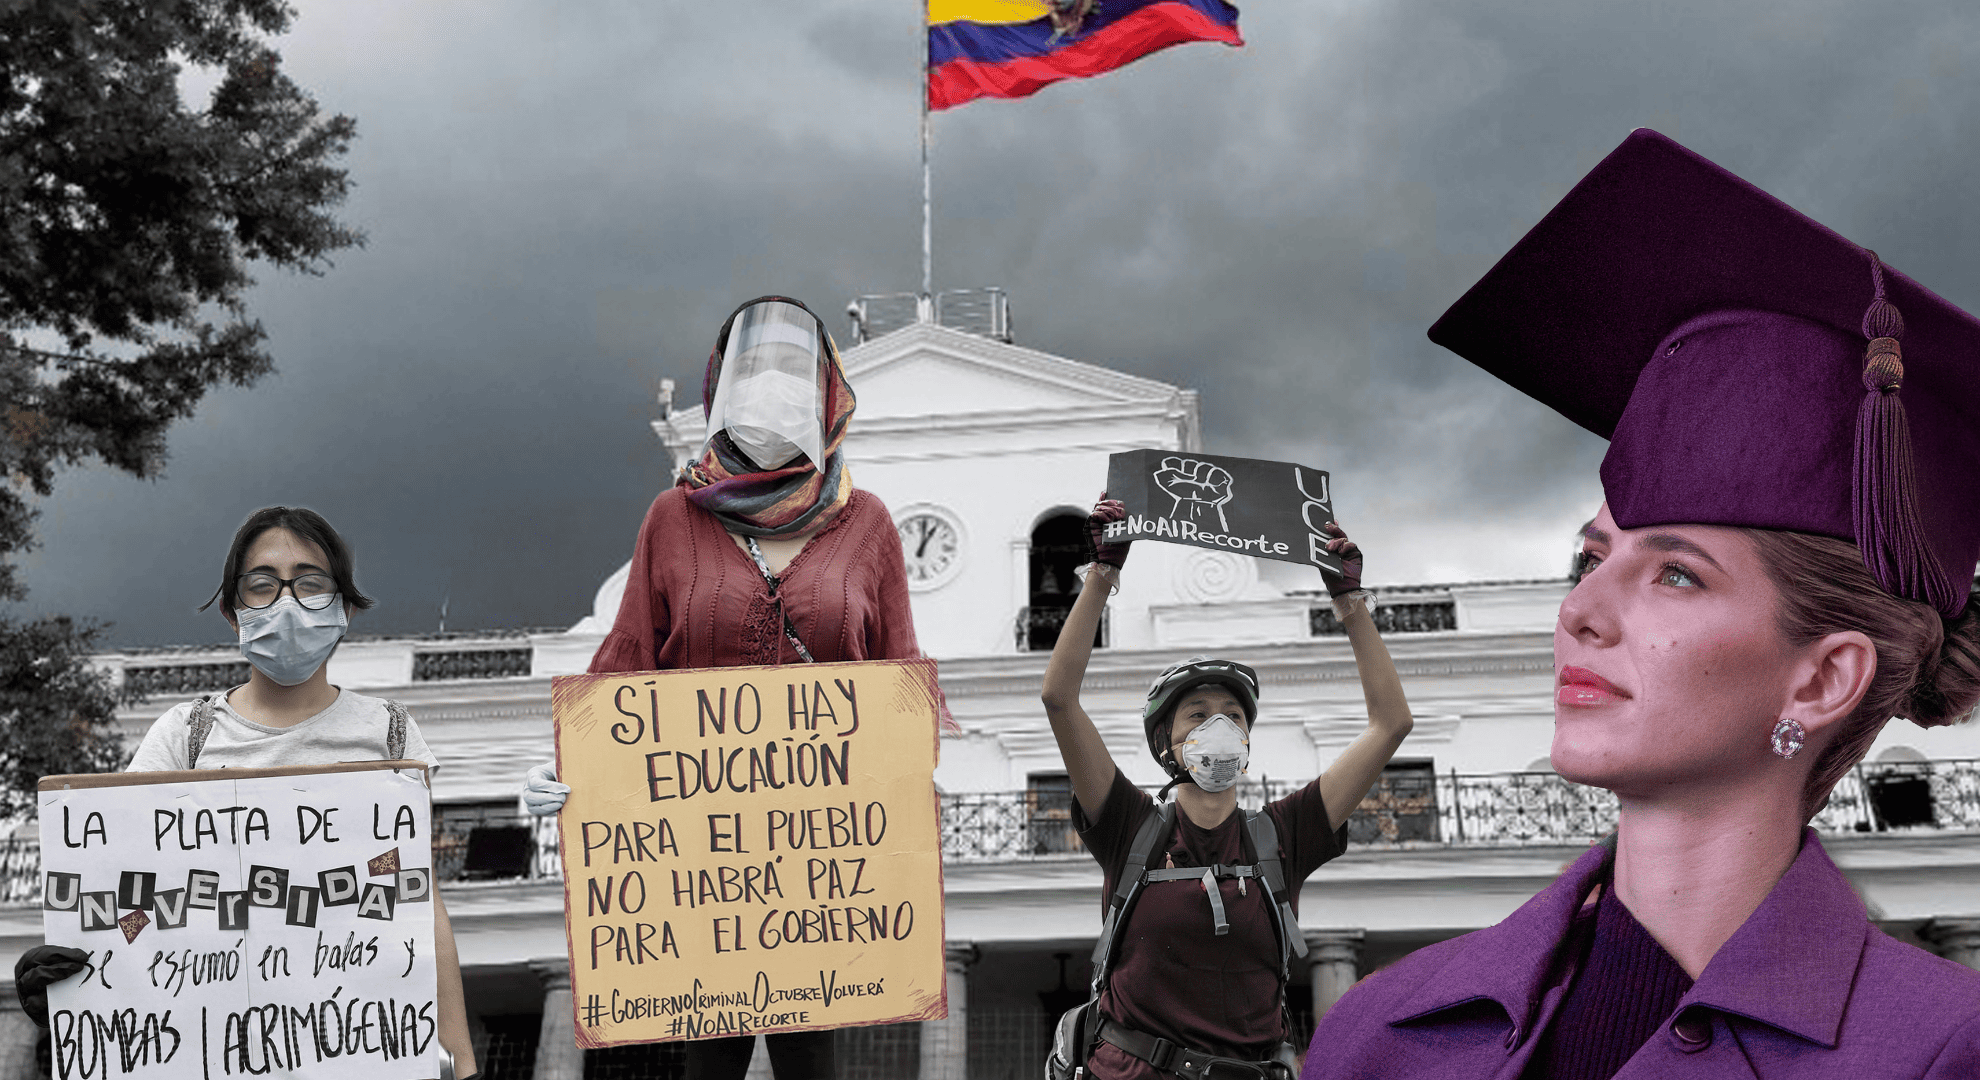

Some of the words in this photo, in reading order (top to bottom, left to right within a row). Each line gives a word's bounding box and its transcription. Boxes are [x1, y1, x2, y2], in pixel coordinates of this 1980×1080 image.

[1294, 466, 1341, 574] UCE
[697, 682, 762, 738] NO
[787, 678, 860, 738] HAY
[645, 733, 850, 803] EDUCACIÓN
[63, 805, 107, 848] LA
[155, 806, 270, 851] PLATA
[297, 805, 340, 845] DE
[372, 803, 416, 841] LA
[581, 817, 679, 868] PARA
[707, 812, 750, 854] EL
[767, 801, 887, 852] PUEBLO
[588, 870, 647, 917] NO
[672, 855, 784, 909] HABRÁ
[807, 857, 875, 900] PAZ
[78, 950, 113, 989] se
[147, 938, 243, 998] esfumó
[257, 944, 291, 982] en
[313, 930, 378, 979] balas
[401, 937, 416, 979] y
[591, 921, 680, 970] PARA
[713, 915, 747, 954] EL
[758, 900, 914, 950] GOBIERNO
[53, 1007, 182, 1080] BOMBAS
